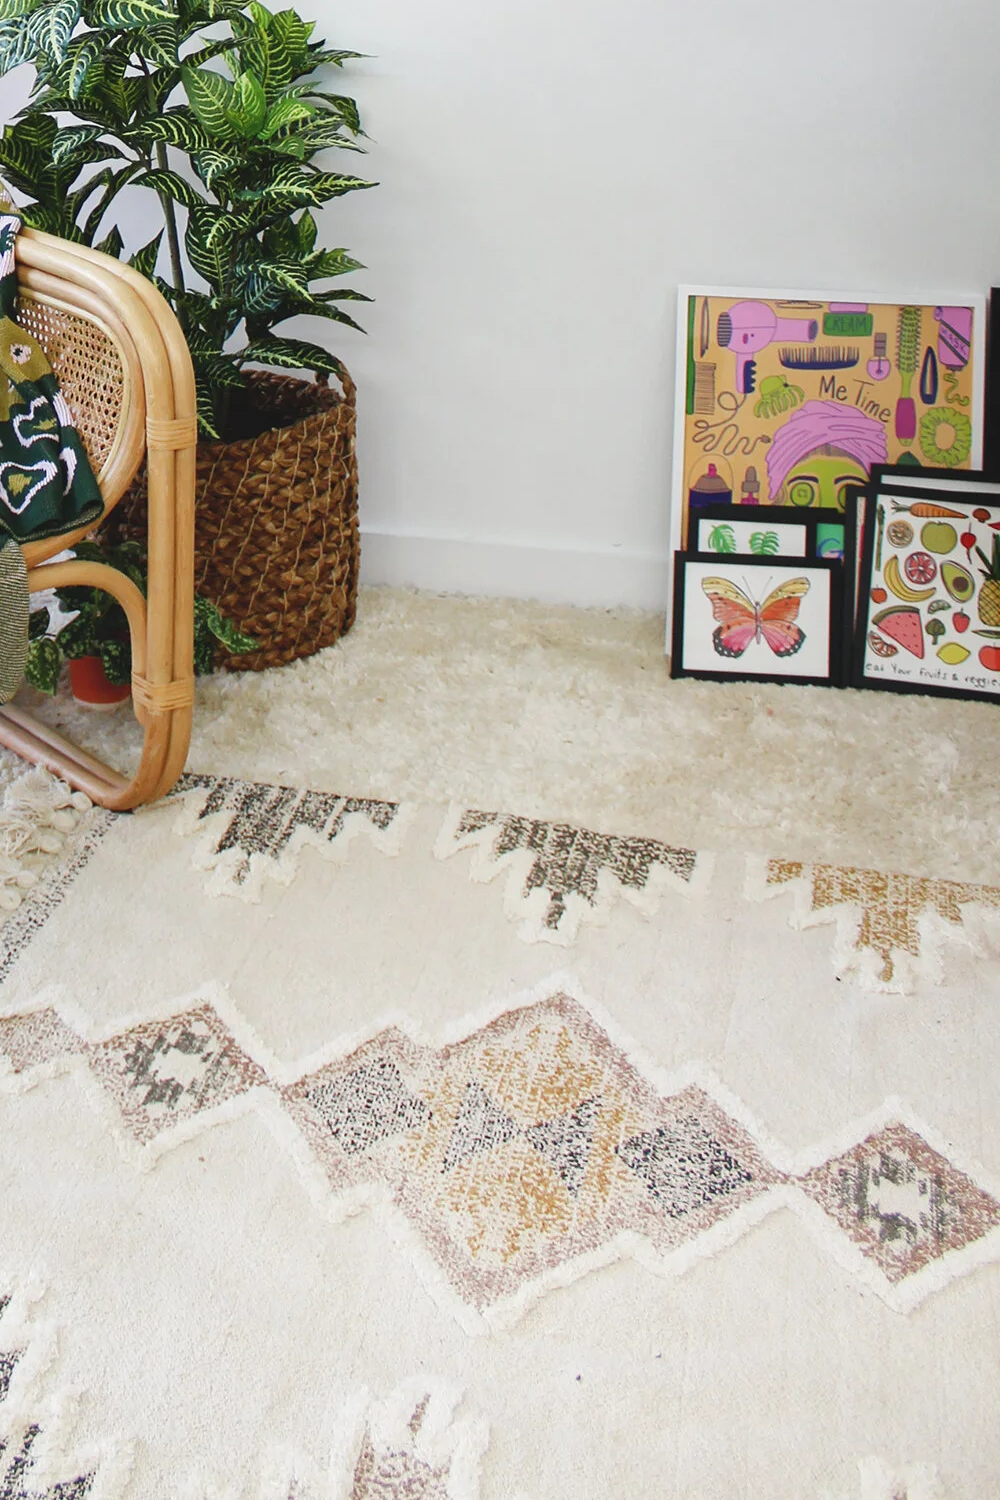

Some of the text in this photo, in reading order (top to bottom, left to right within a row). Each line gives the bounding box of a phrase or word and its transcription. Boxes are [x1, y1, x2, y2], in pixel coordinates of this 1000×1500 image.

[825, 316, 866, 332] CREAM
[819, 375, 891, 423] Me Time
